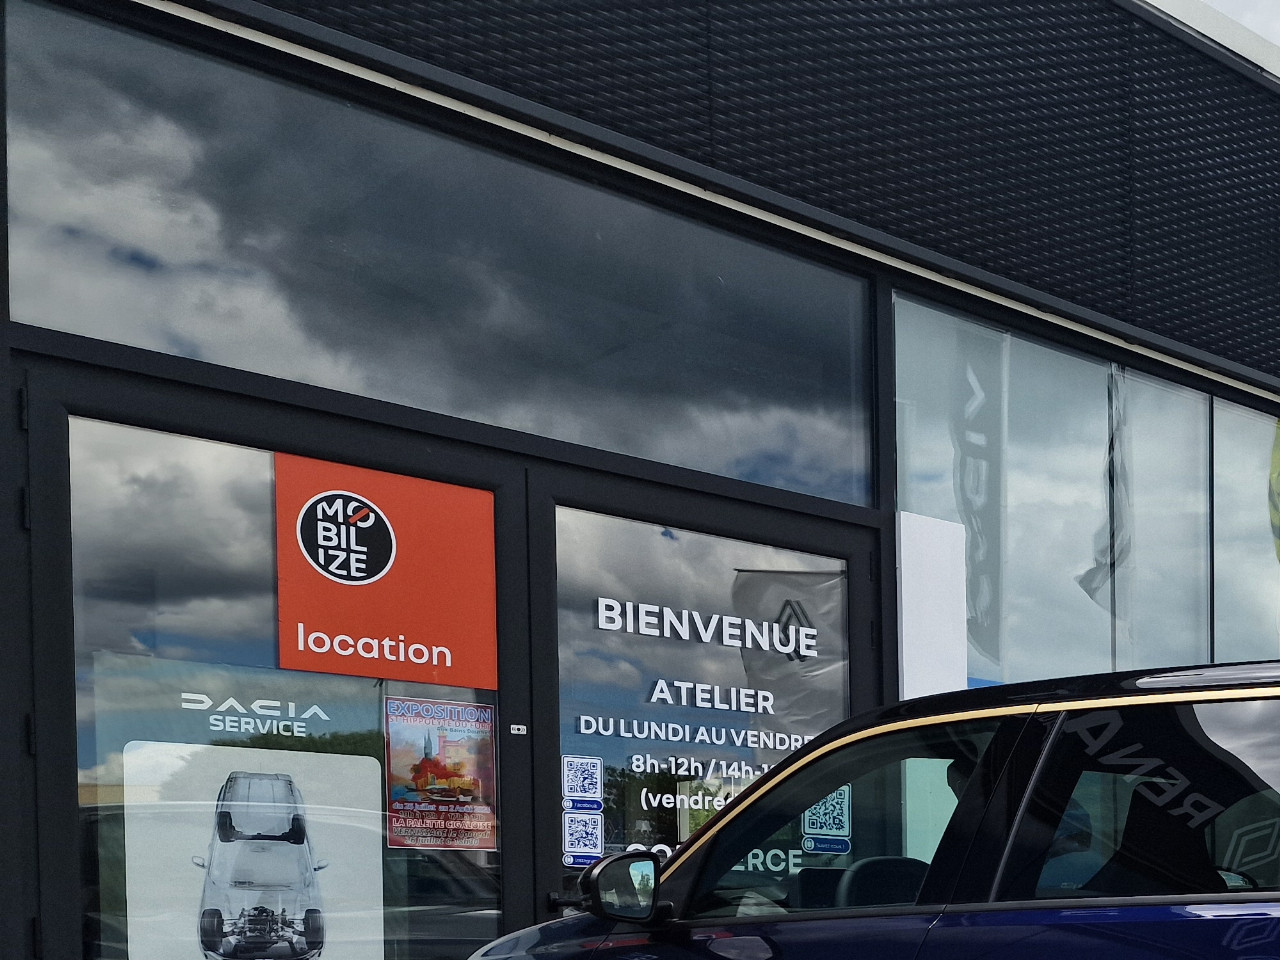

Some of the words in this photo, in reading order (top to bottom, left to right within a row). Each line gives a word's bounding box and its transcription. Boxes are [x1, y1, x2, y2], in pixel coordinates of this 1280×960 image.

[597, 597, 818, 658] BIENVENUE
[297, 622, 452, 667] location
[181, 692, 331, 721] DACIA
[650, 678, 776, 715] ATELIER
[387, 700, 491, 723] EXPOSITION
[209, 714, 307, 738] SERVICE
[579, 715, 614, 736] DU
[619, 718, 690, 742] LUNDI
[695, 725, 726, 745] AU
[631, 754, 703, 777] 8h-12h
[705, 758, 717, 780] /
[640, 787, 739, 811] (vendre
[392, 818, 405, 827] LA
[406, 818, 444, 828] PALETTE
